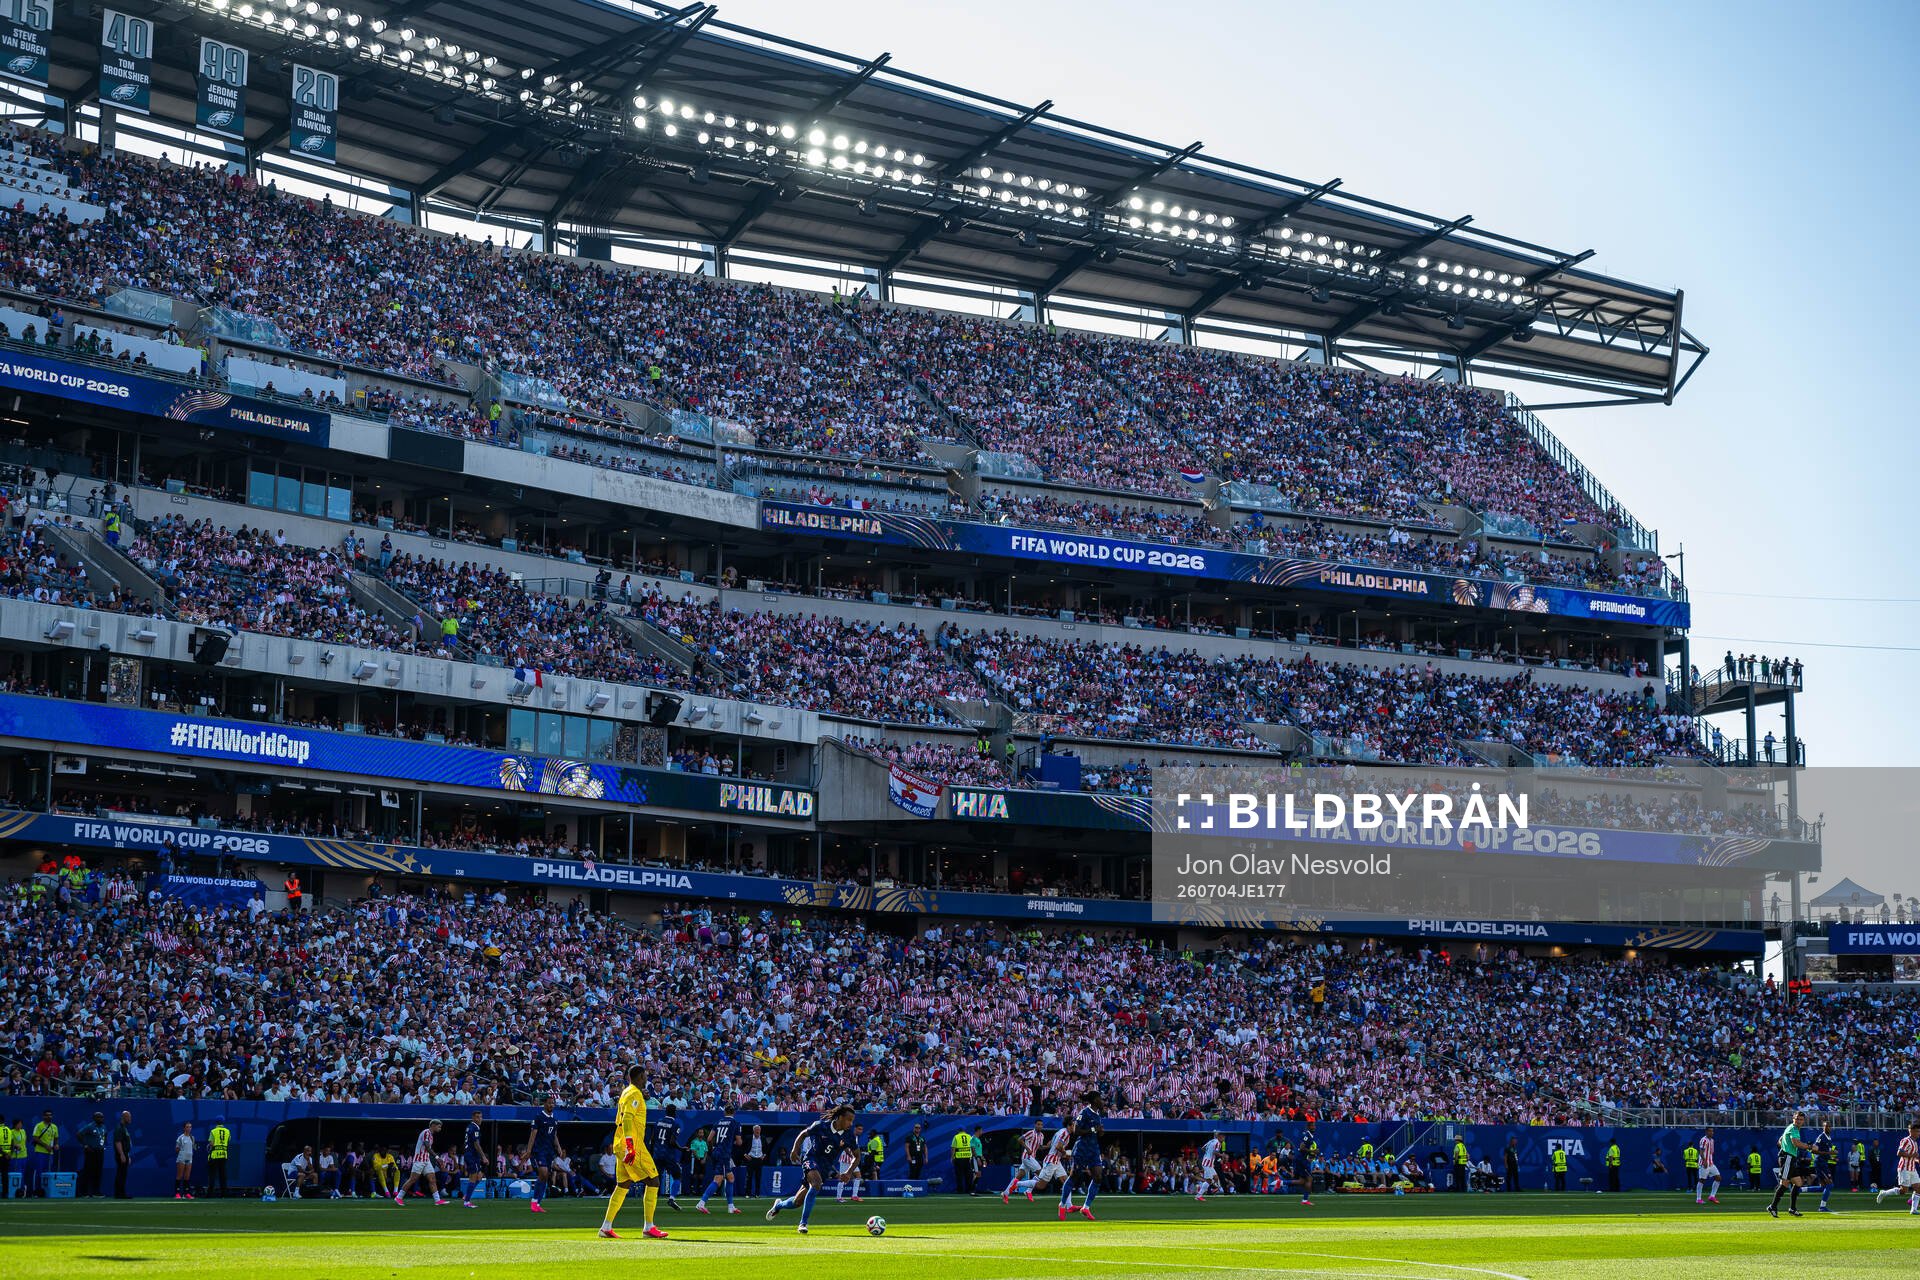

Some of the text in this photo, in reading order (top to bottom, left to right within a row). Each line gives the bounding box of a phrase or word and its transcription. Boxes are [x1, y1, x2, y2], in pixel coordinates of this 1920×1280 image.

[2, 35, 46, 56] VAN BUREN
[12, 28, 37, 43] STEVE
[107, 13, 148, 59] 40
[103, 64, 149, 84] BROOKSHIER
[118, 58, 135, 71] TOM
[204, 41, 245, 87] 99
[207, 84, 238, 99] JEROME
[295, 67, 336, 112] 20
[208, 94, 237, 109] BROWN
[297, 118, 332, 134] DAWKINS
[303, 110, 326, 124] BRIAN
[13, 365, 58, 383] WORLD
[60, 374, 85, 388] CUP
[86, 380, 129, 398] 2026
[230, 408, 310, 433] PHILADELPHIA
[1011, 535, 1205, 570] FIFA WORLD CUP 2026
[1320, 570, 1428, 594] PHILADELPHIA
[1590, 600, 1646, 618] #FIFAWorldCup
[170, 722, 310, 764] #FIFAWorldCup
[720, 783, 813, 816] PHILAD
[952, 791, 1009, 818] HIA
[74, 823, 270, 854] FIFA WORLD CUP 2026
[114, 841, 124, 849] 101
[1512, 828, 1601, 857] 2026
[168, 875, 257, 888] FIFA WORLD CUP 2026
[533, 862, 692, 889] PHILADELPHIA
[1027, 900, 1084, 914] #FIFAWorldCup
[1408, 919, 1549, 937] PHILADELPHIA
[1848, 932, 1886, 946] FIFA
[658, 1128, 666, 1145] 4
[716, 1126, 729, 1144] 14
